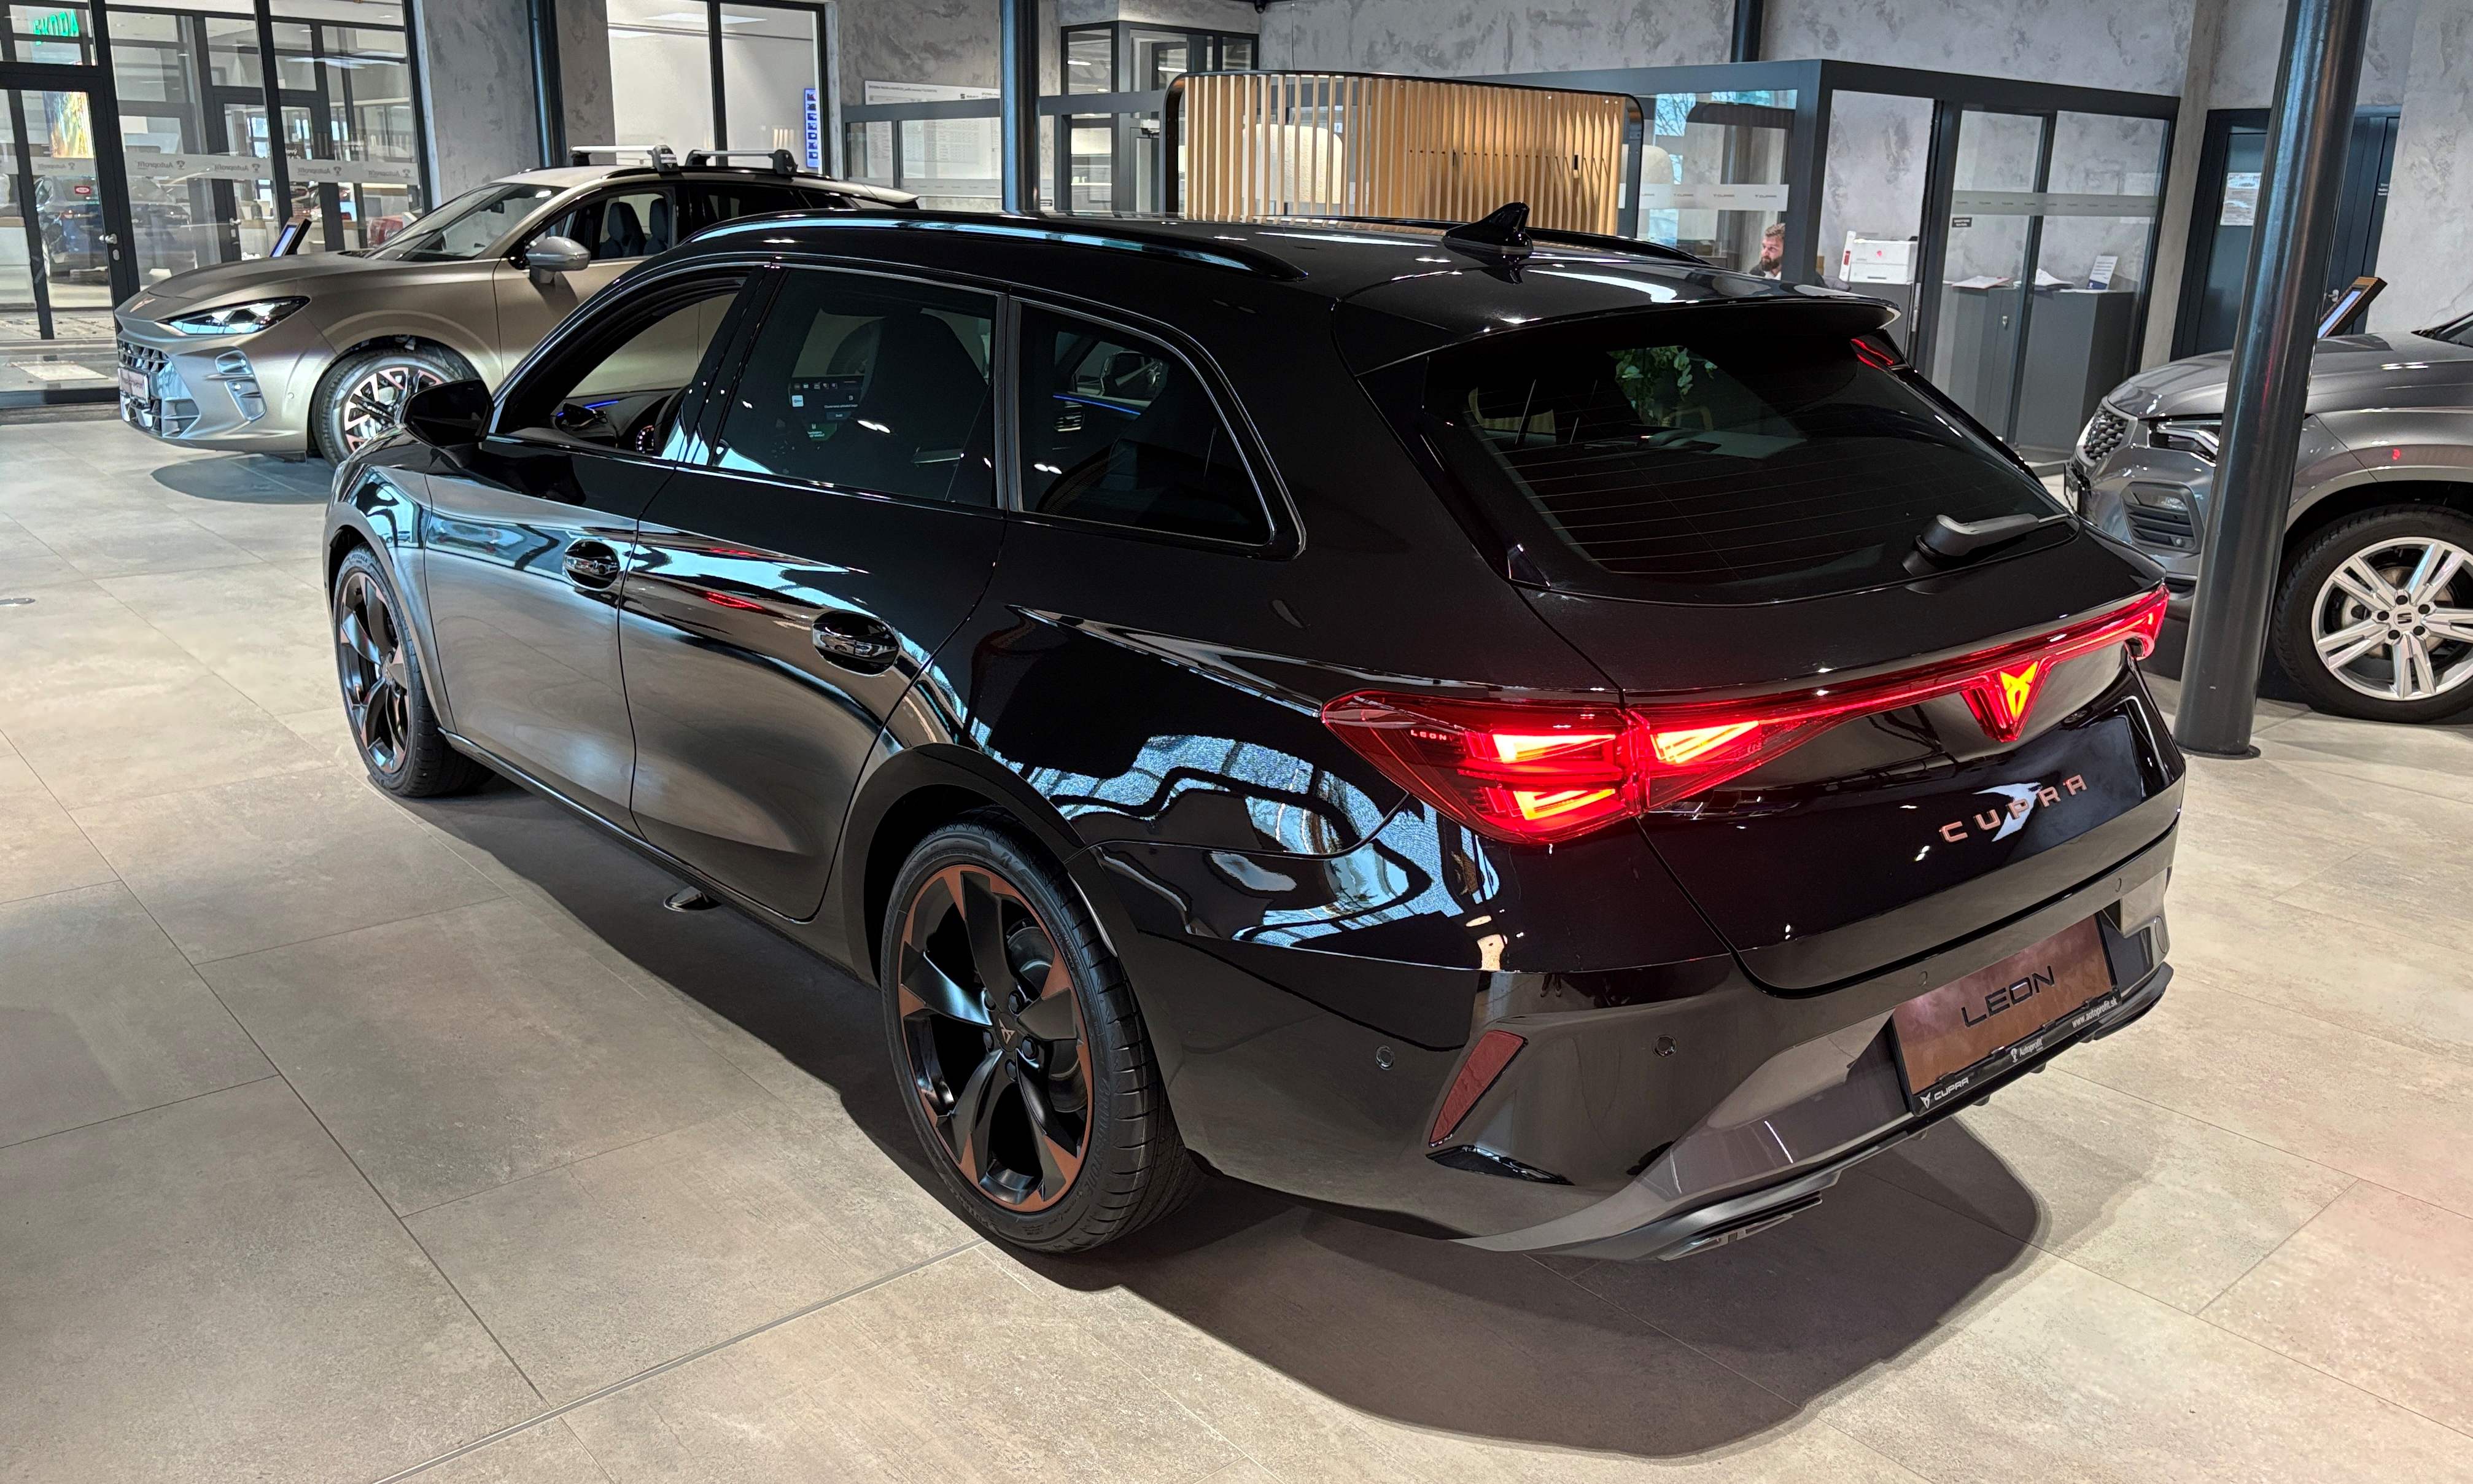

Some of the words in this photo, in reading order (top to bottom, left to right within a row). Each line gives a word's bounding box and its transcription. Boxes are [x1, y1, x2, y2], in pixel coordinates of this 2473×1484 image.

[1410, 729, 1446, 740] LEON
[1940, 774, 2087, 843] CUPRA
[1962, 965, 2055, 1028] LEON
[2071, 996, 2119, 1028] www.autoprofit.sk
[2019, 1038, 2043, 1057] Autoprofit
[1934, 1077, 1969, 1101] CUPRA
